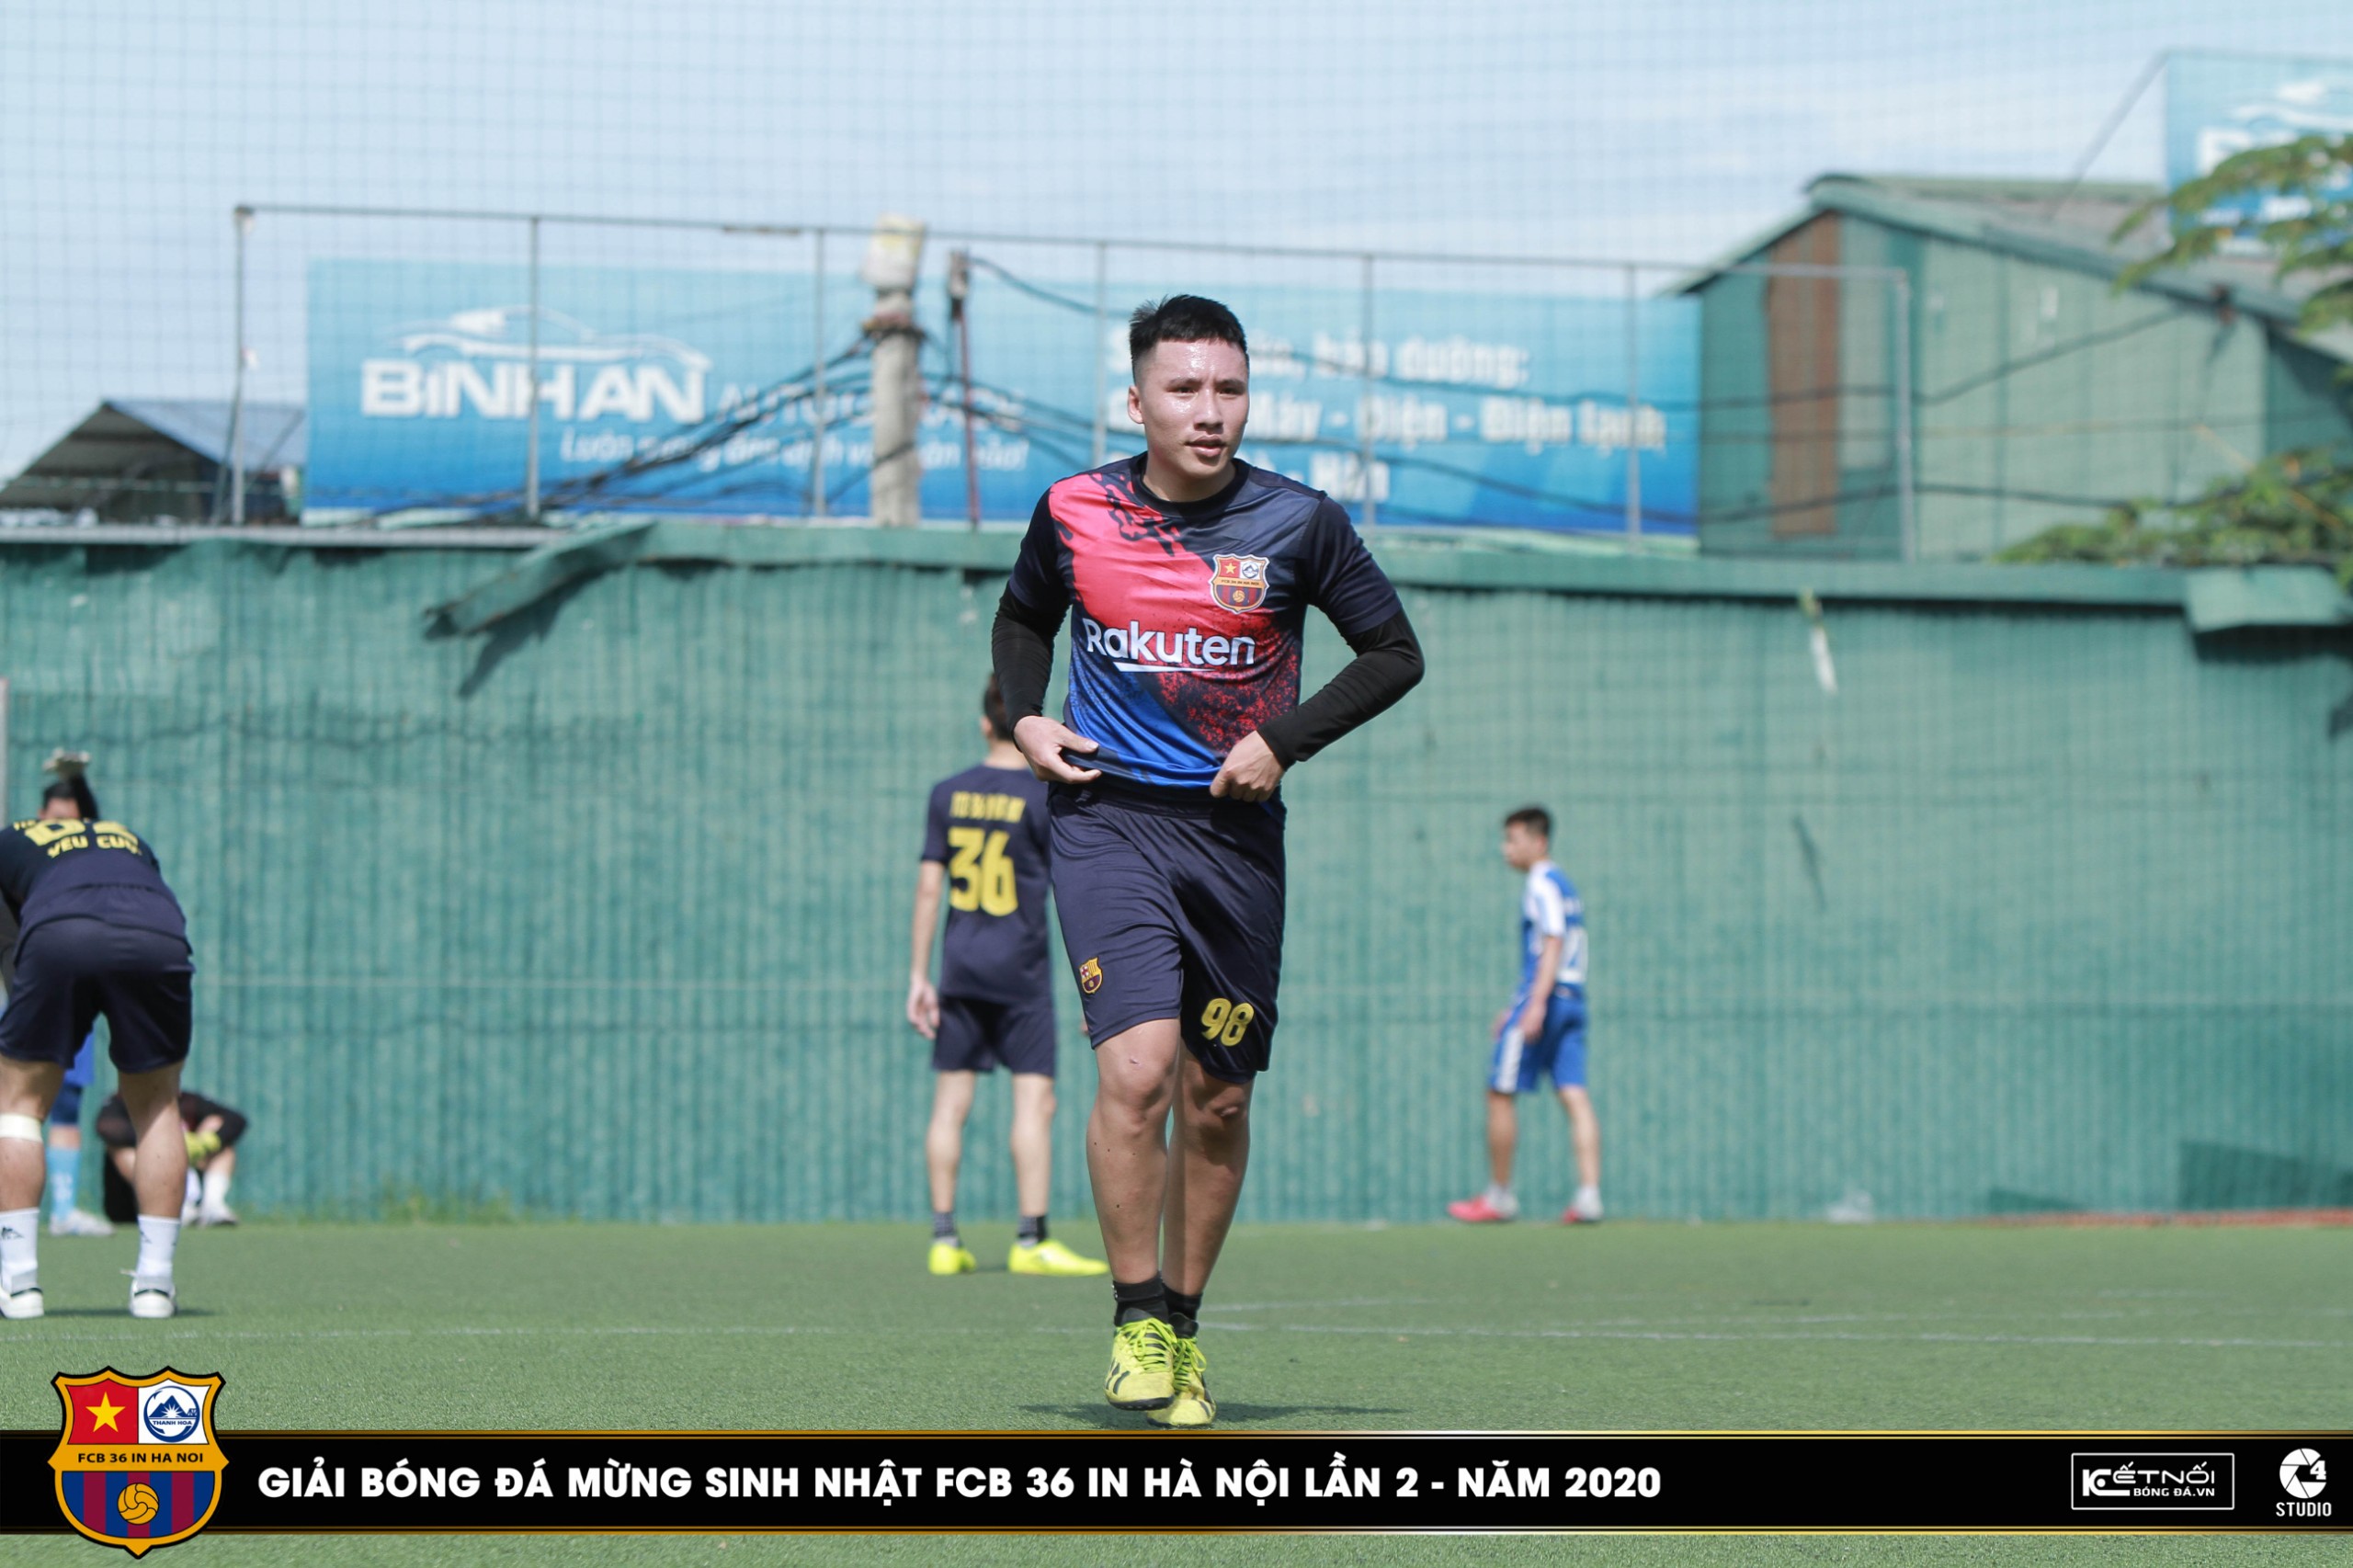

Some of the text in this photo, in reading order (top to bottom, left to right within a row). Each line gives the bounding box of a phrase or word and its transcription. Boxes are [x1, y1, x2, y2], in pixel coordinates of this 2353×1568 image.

[1082, 618, 1256, 665] Rakuten
[948, 826, 1018, 916] 36
[1201, 998, 1255, 1047] 98
